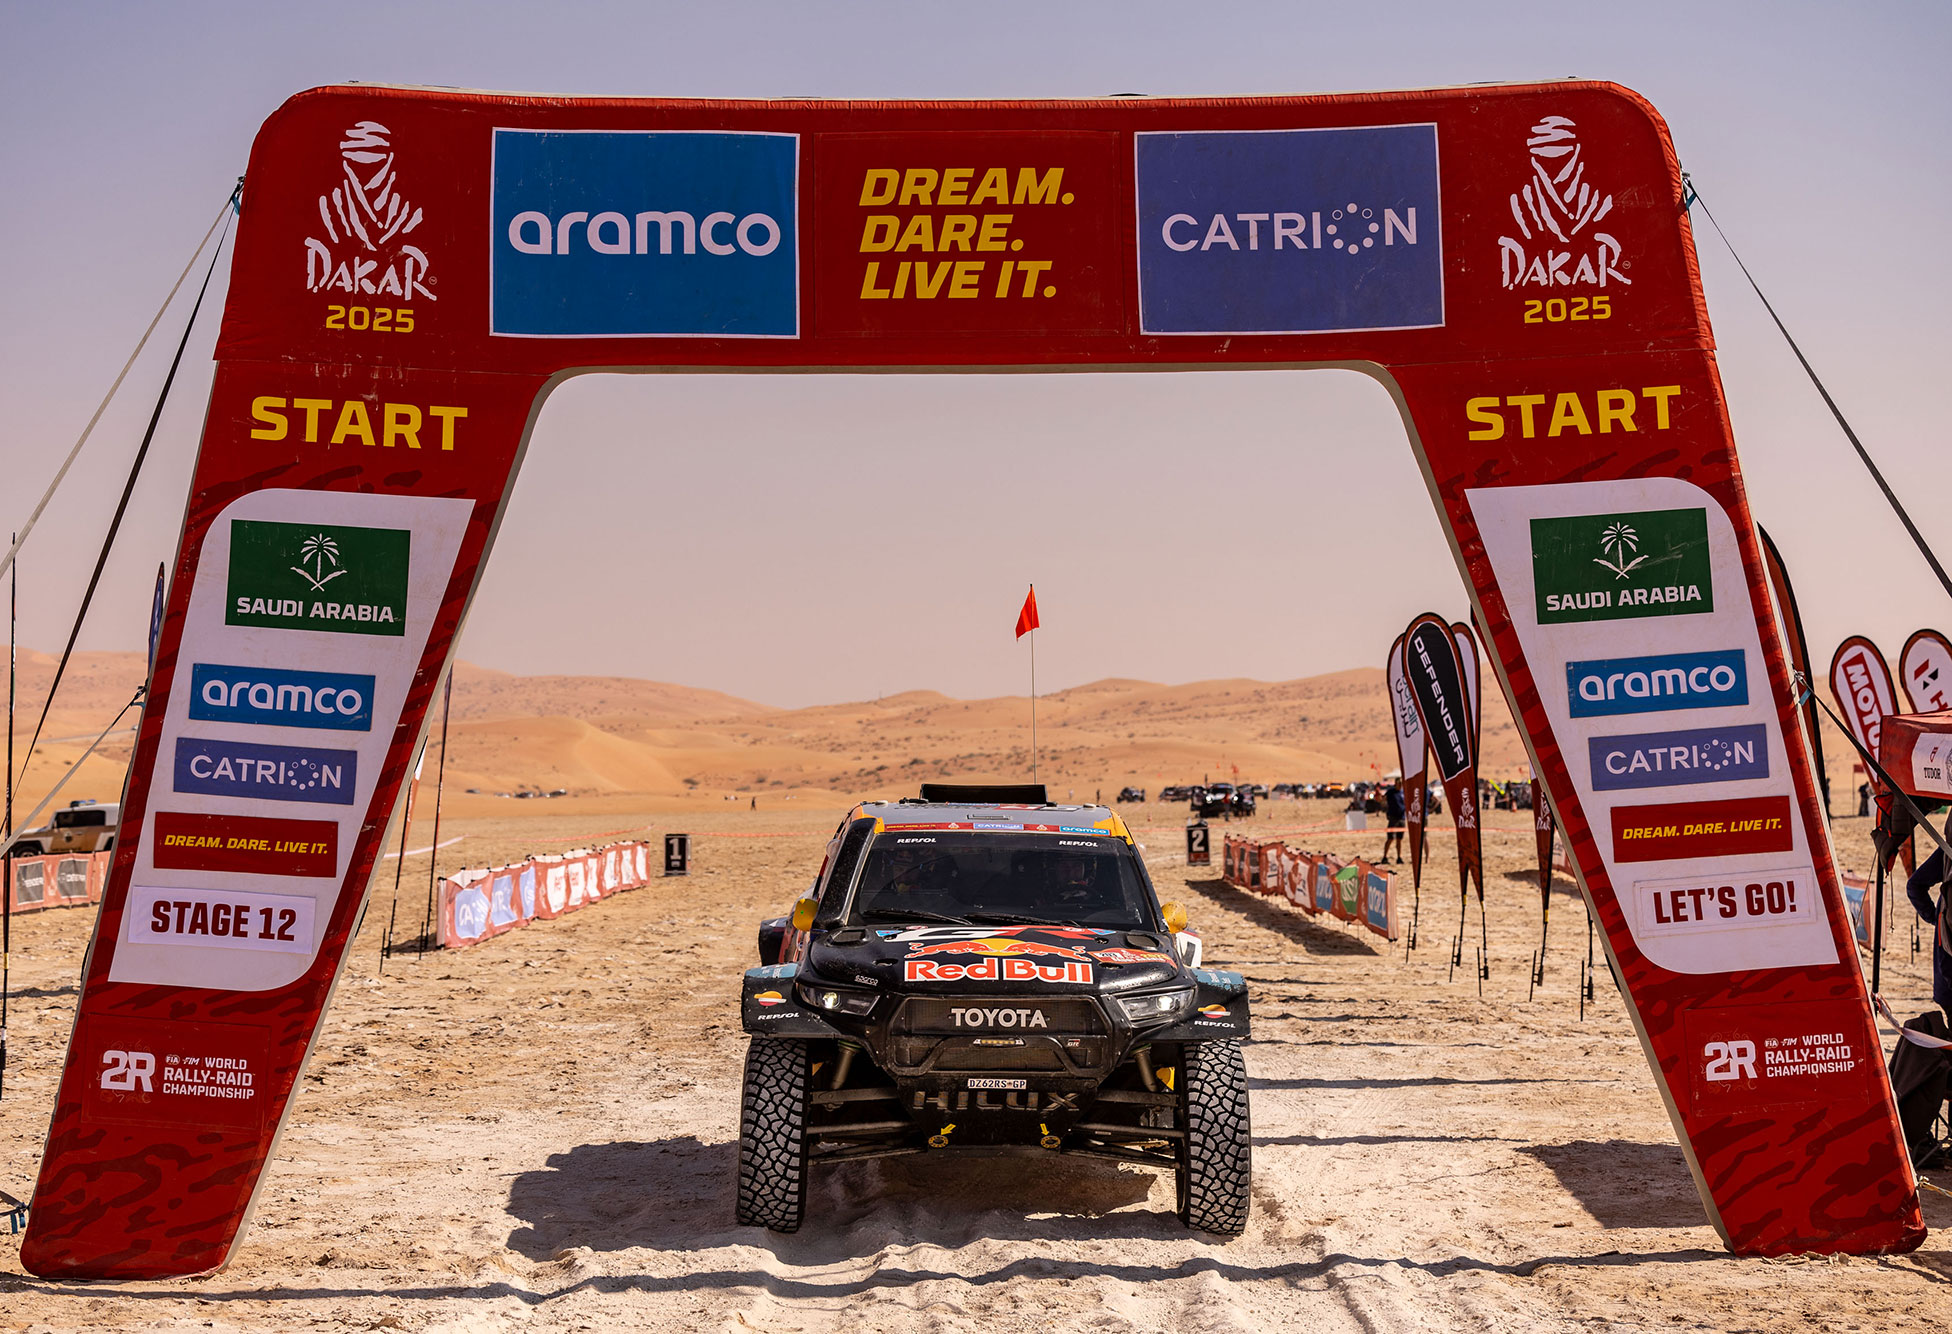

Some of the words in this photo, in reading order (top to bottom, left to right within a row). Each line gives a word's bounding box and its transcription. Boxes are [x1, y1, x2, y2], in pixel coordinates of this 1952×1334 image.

[859, 168, 1075, 206] DREAM.
[508, 211, 781, 256] aramco
[859, 214, 1024, 253] DARE.
[1162, 203, 1418, 254] CATRION
[305, 237, 437, 301] DAKAR
[1498, 233, 1632, 290] DAKAR
[859, 261, 979, 299] LIVE
[996, 261, 1057, 299] IT.
[326, 305, 415, 333] 2025
[1524, 296, 1612, 324] 2025
[250, 395, 468, 451] START
[1465, 385, 1681, 441] START
[236, 596, 303, 617] SAUDI
[309, 601, 395, 623] ARABIA
[1546, 590, 1612, 612] SAUDI
[1618, 584, 1702, 607] ARABIA
[1579, 665, 1736, 701] aramco
[202, 679, 362, 716] aramco
[1414, 636, 1465, 765] DEFENDER
[1605, 739, 1754, 775] CATRION
[190, 754, 342, 790] CATRION
[1923, 767, 1941, 780] TUDOR
[1191, 830, 1204, 852] 2
[1622, 825, 1680, 840] DREAM.
[1683, 822, 1726, 836] DARE.
[1730, 819, 1762, 833] LIVE
[1765, 817, 1782, 831] IT.
[164, 834, 224, 849] DREAM.
[226, 837, 272, 852] DARE.
[275, 840, 307, 854] LIVE
[310, 842, 328, 855] IT.
[669, 838, 682, 860] 1
[1653, 885, 1738, 925] LET’S
[1745, 880, 1797, 915] GO!
[151, 900, 250, 939] STAGE
[258, 907, 297, 942] 12
[904, 958, 999, 982] Red
[1003, 958, 1094, 985] Bull
[757, 1012, 800, 1020] REPSOL
[951, 1008, 1048, 1028] TOYOTA
[1194, 1020, 1236, 1029] REPSOL
[1765, 1038, 1779, 1048] FIA
[1781, 1038, 1798, 1047] FIM
[1802, 1033, 1844, 1046] WORLD
[165, 1054, 180, 1065] FIA
[182, 1057, 200, 1066] FIM
[204, 1057, 247, 1070] WORLD
[1704, 1040, 1758, 1082] 2R
[1765, 1046, 1851, 1065] RALLY-RAID
[1766, 1061, 1855, 1078] CHAMPIONSHIP
[101, 1050, 156, 1093] 2R
[164, 1067, 253, 1087] RALLY-RAID
[969, 1079, 1008, 1089] DZ62RS
[1012, 1080, 1026, 1089] GP
[162, 1083, 255, 1100] CHAMPIONSHIP
[913, 1091, 1080, 1111] HILUX
